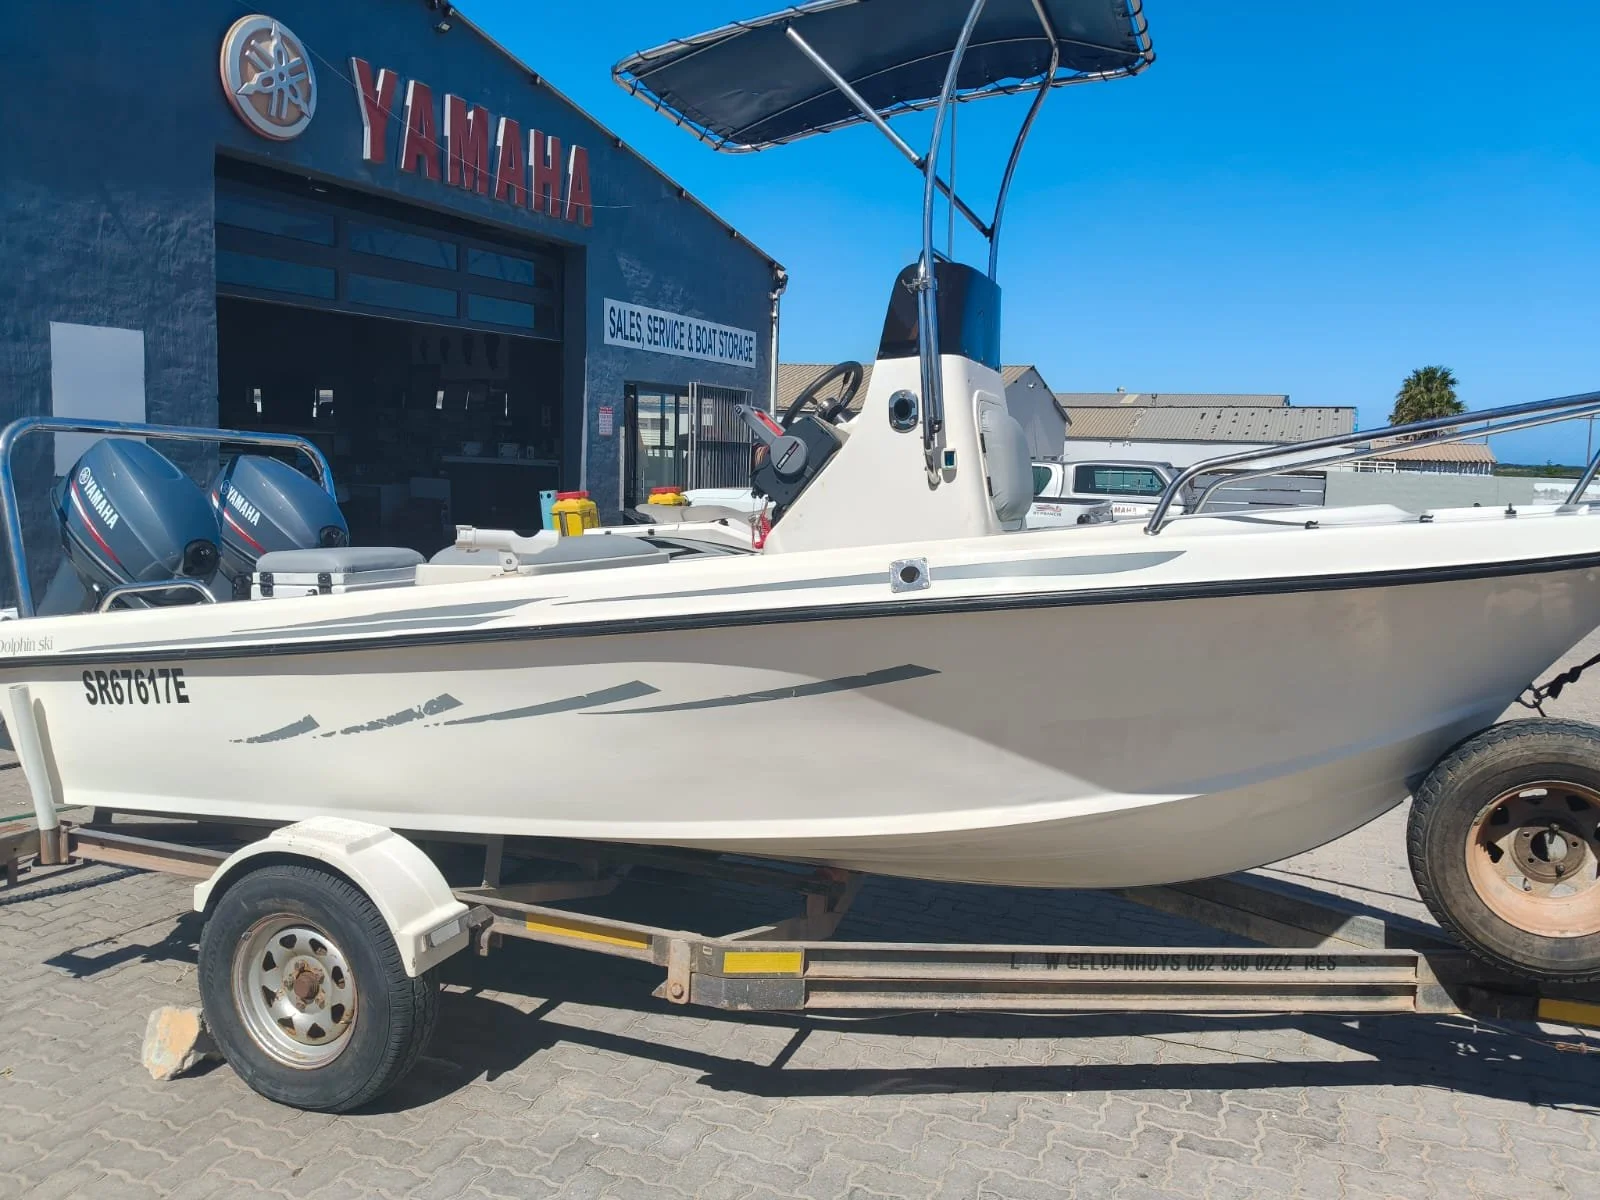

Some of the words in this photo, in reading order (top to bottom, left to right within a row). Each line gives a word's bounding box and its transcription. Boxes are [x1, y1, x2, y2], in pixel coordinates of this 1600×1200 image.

[350, 56, 593, 228] YAMAHA
[609, 306, 645, 348] SALES,
[647, 314, 684, 351] SERVICE
[687, 322, 694, 353] &
[695, 324, 717, 357] BOAT
[719, 330, 753, 363] STORAGE
[84, 475, 120, 530] YAMAHA
[226, 486, 262, 527] YAMAHA
[38, 634, 54, 652] ski
[82, 667, 190, 706] SR67617E
[1304, 954, 1337, 971] RES
